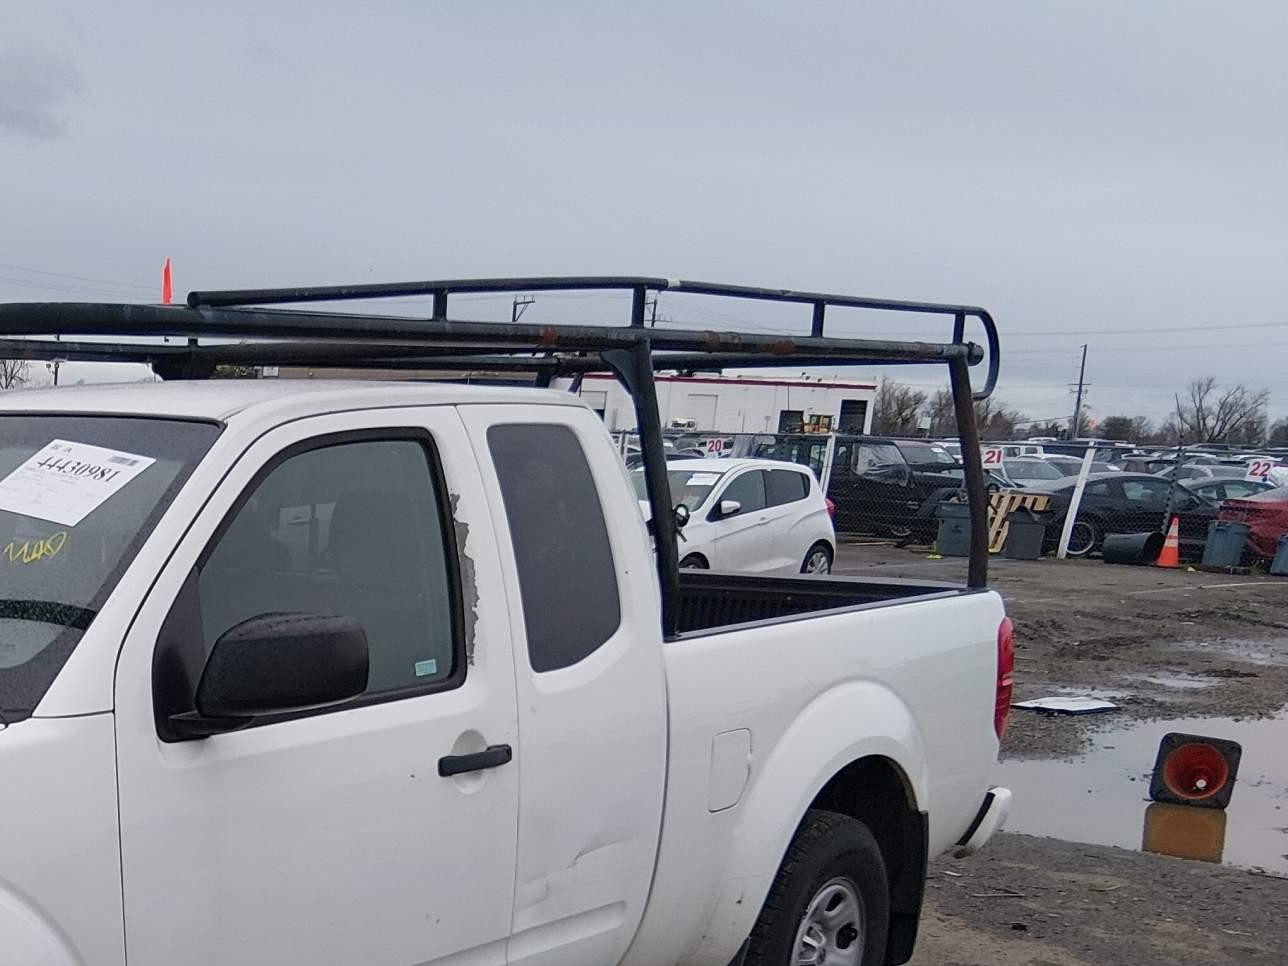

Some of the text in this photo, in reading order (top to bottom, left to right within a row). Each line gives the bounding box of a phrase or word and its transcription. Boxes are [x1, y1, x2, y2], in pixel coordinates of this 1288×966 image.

[708, 440, 722, 452] 20
[983, 450, 1002, 464] 21
[37, 456, 120, 482] 44430981
[1248, 461, 1272, 477] 22
